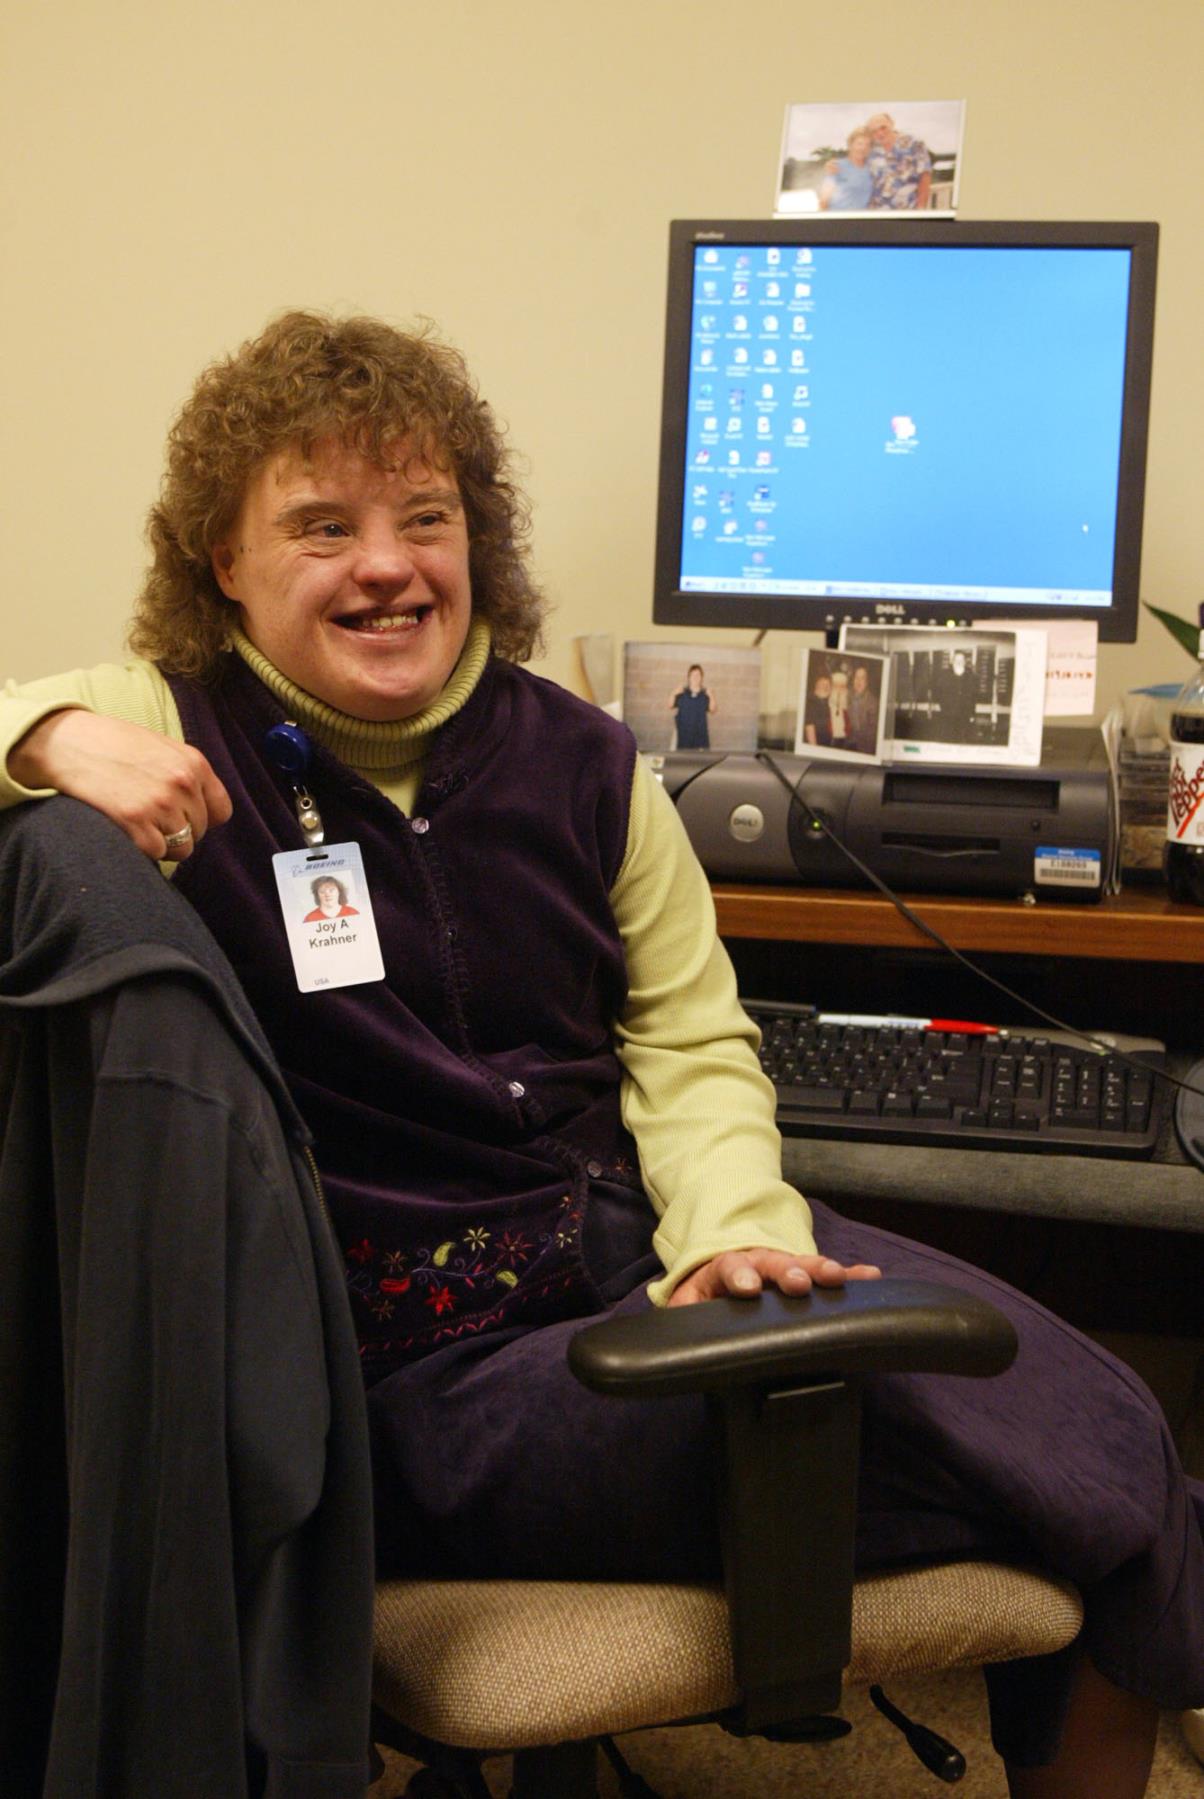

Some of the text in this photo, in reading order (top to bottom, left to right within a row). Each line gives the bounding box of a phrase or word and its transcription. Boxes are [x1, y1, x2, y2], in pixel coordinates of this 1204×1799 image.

[876, 604, 905, 615] DELL
[315, 919, 349, 934] Joy A
[308, 933, 358, 949] Krahner
